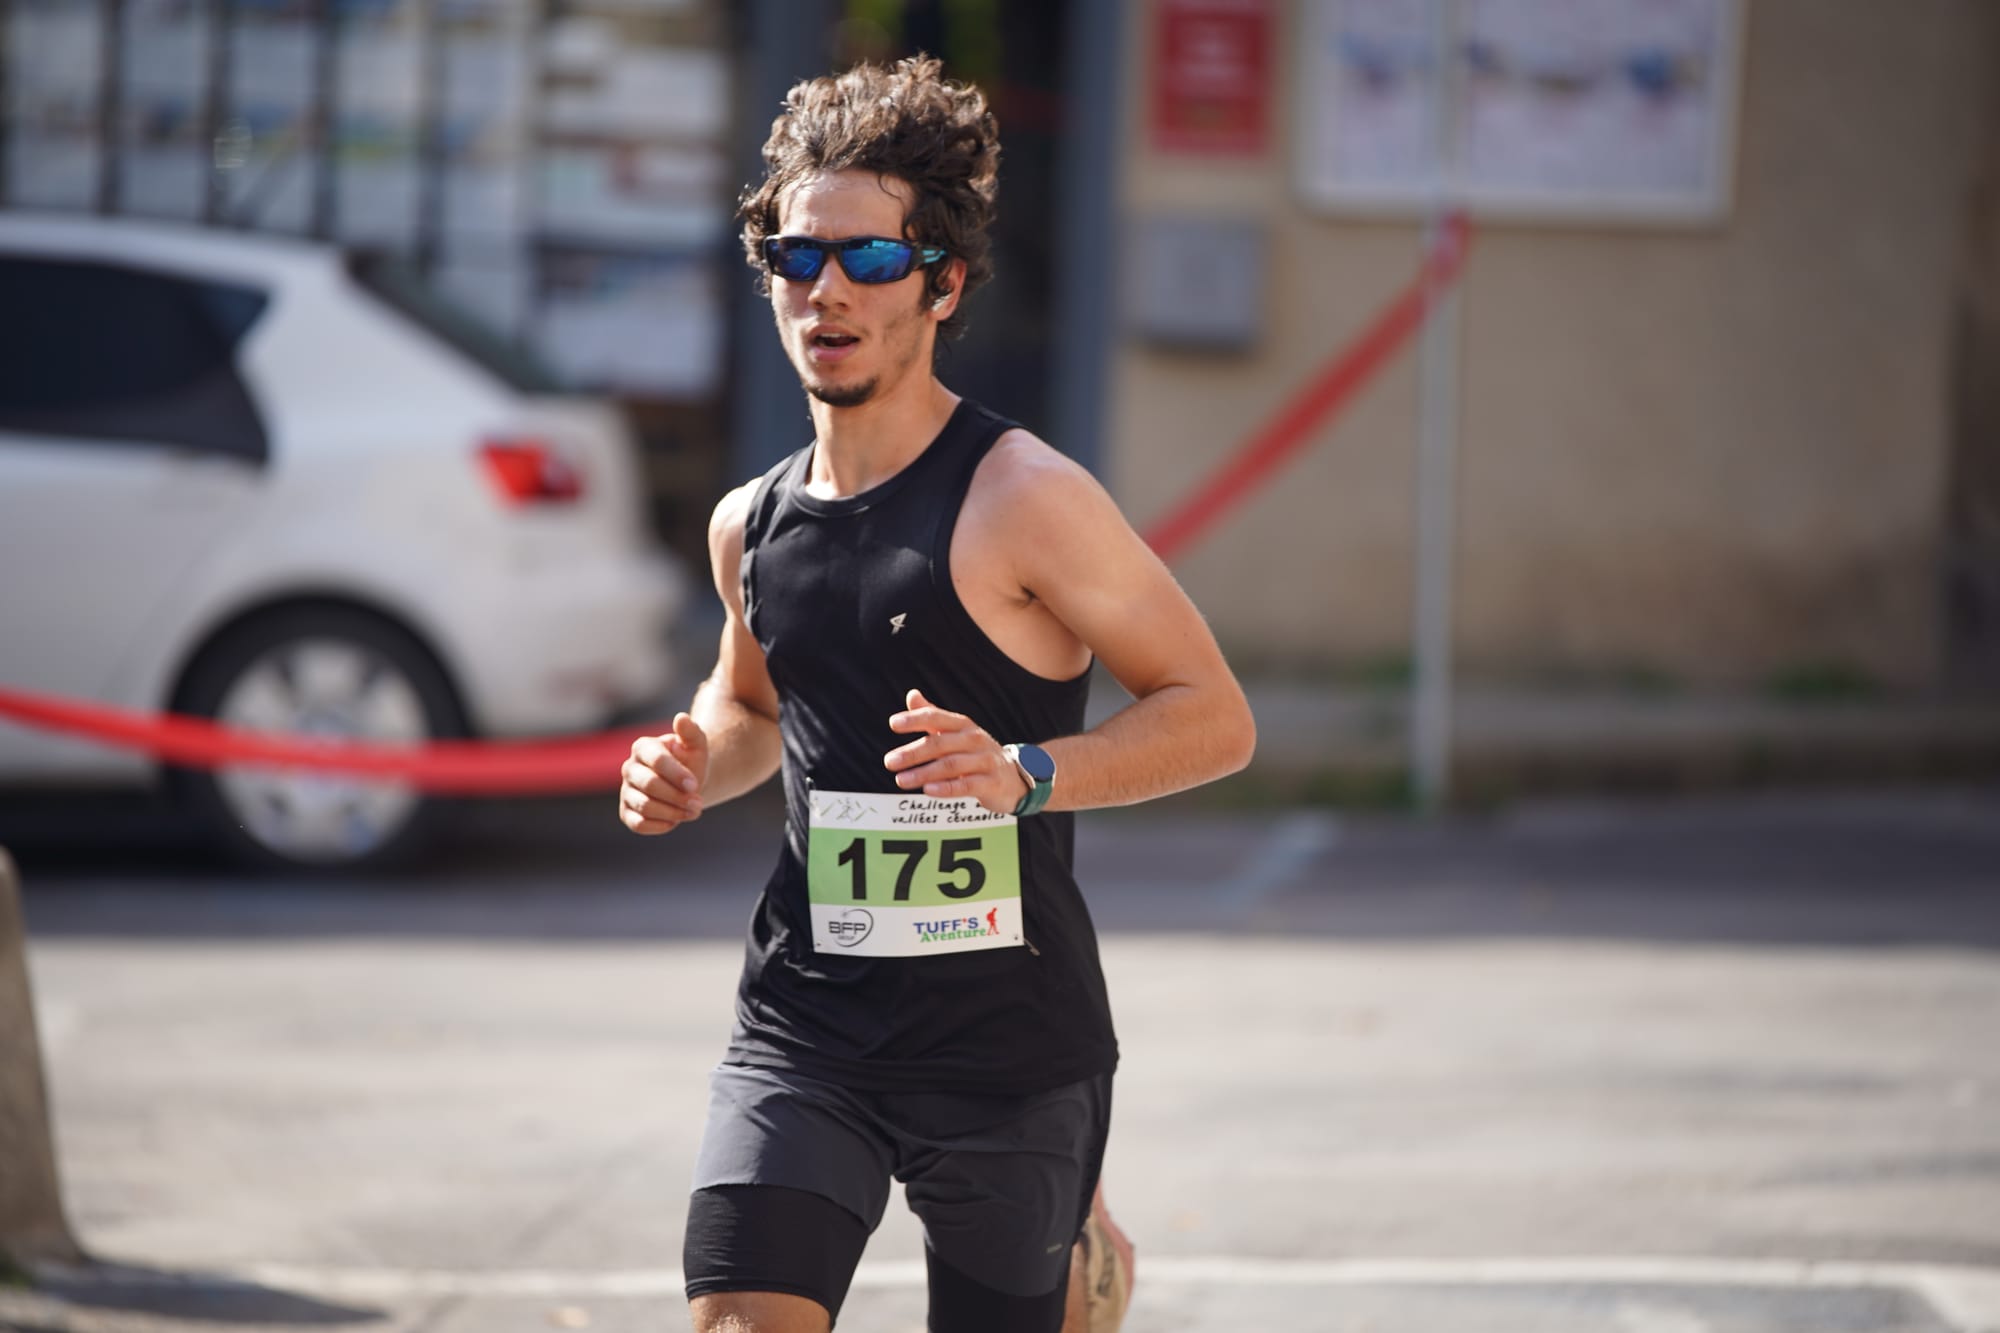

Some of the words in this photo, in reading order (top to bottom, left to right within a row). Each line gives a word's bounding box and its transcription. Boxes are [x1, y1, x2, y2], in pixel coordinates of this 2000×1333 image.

[898, 799, 967, 814] Challenge
[891, 811, 939, 824] vallées
[946, 810, 1005, 824] cévenoles
[837, 837, 987, 901] 175
[828, 921, 867, 935] BFP
[919, 928, 987, 943] Aventure
